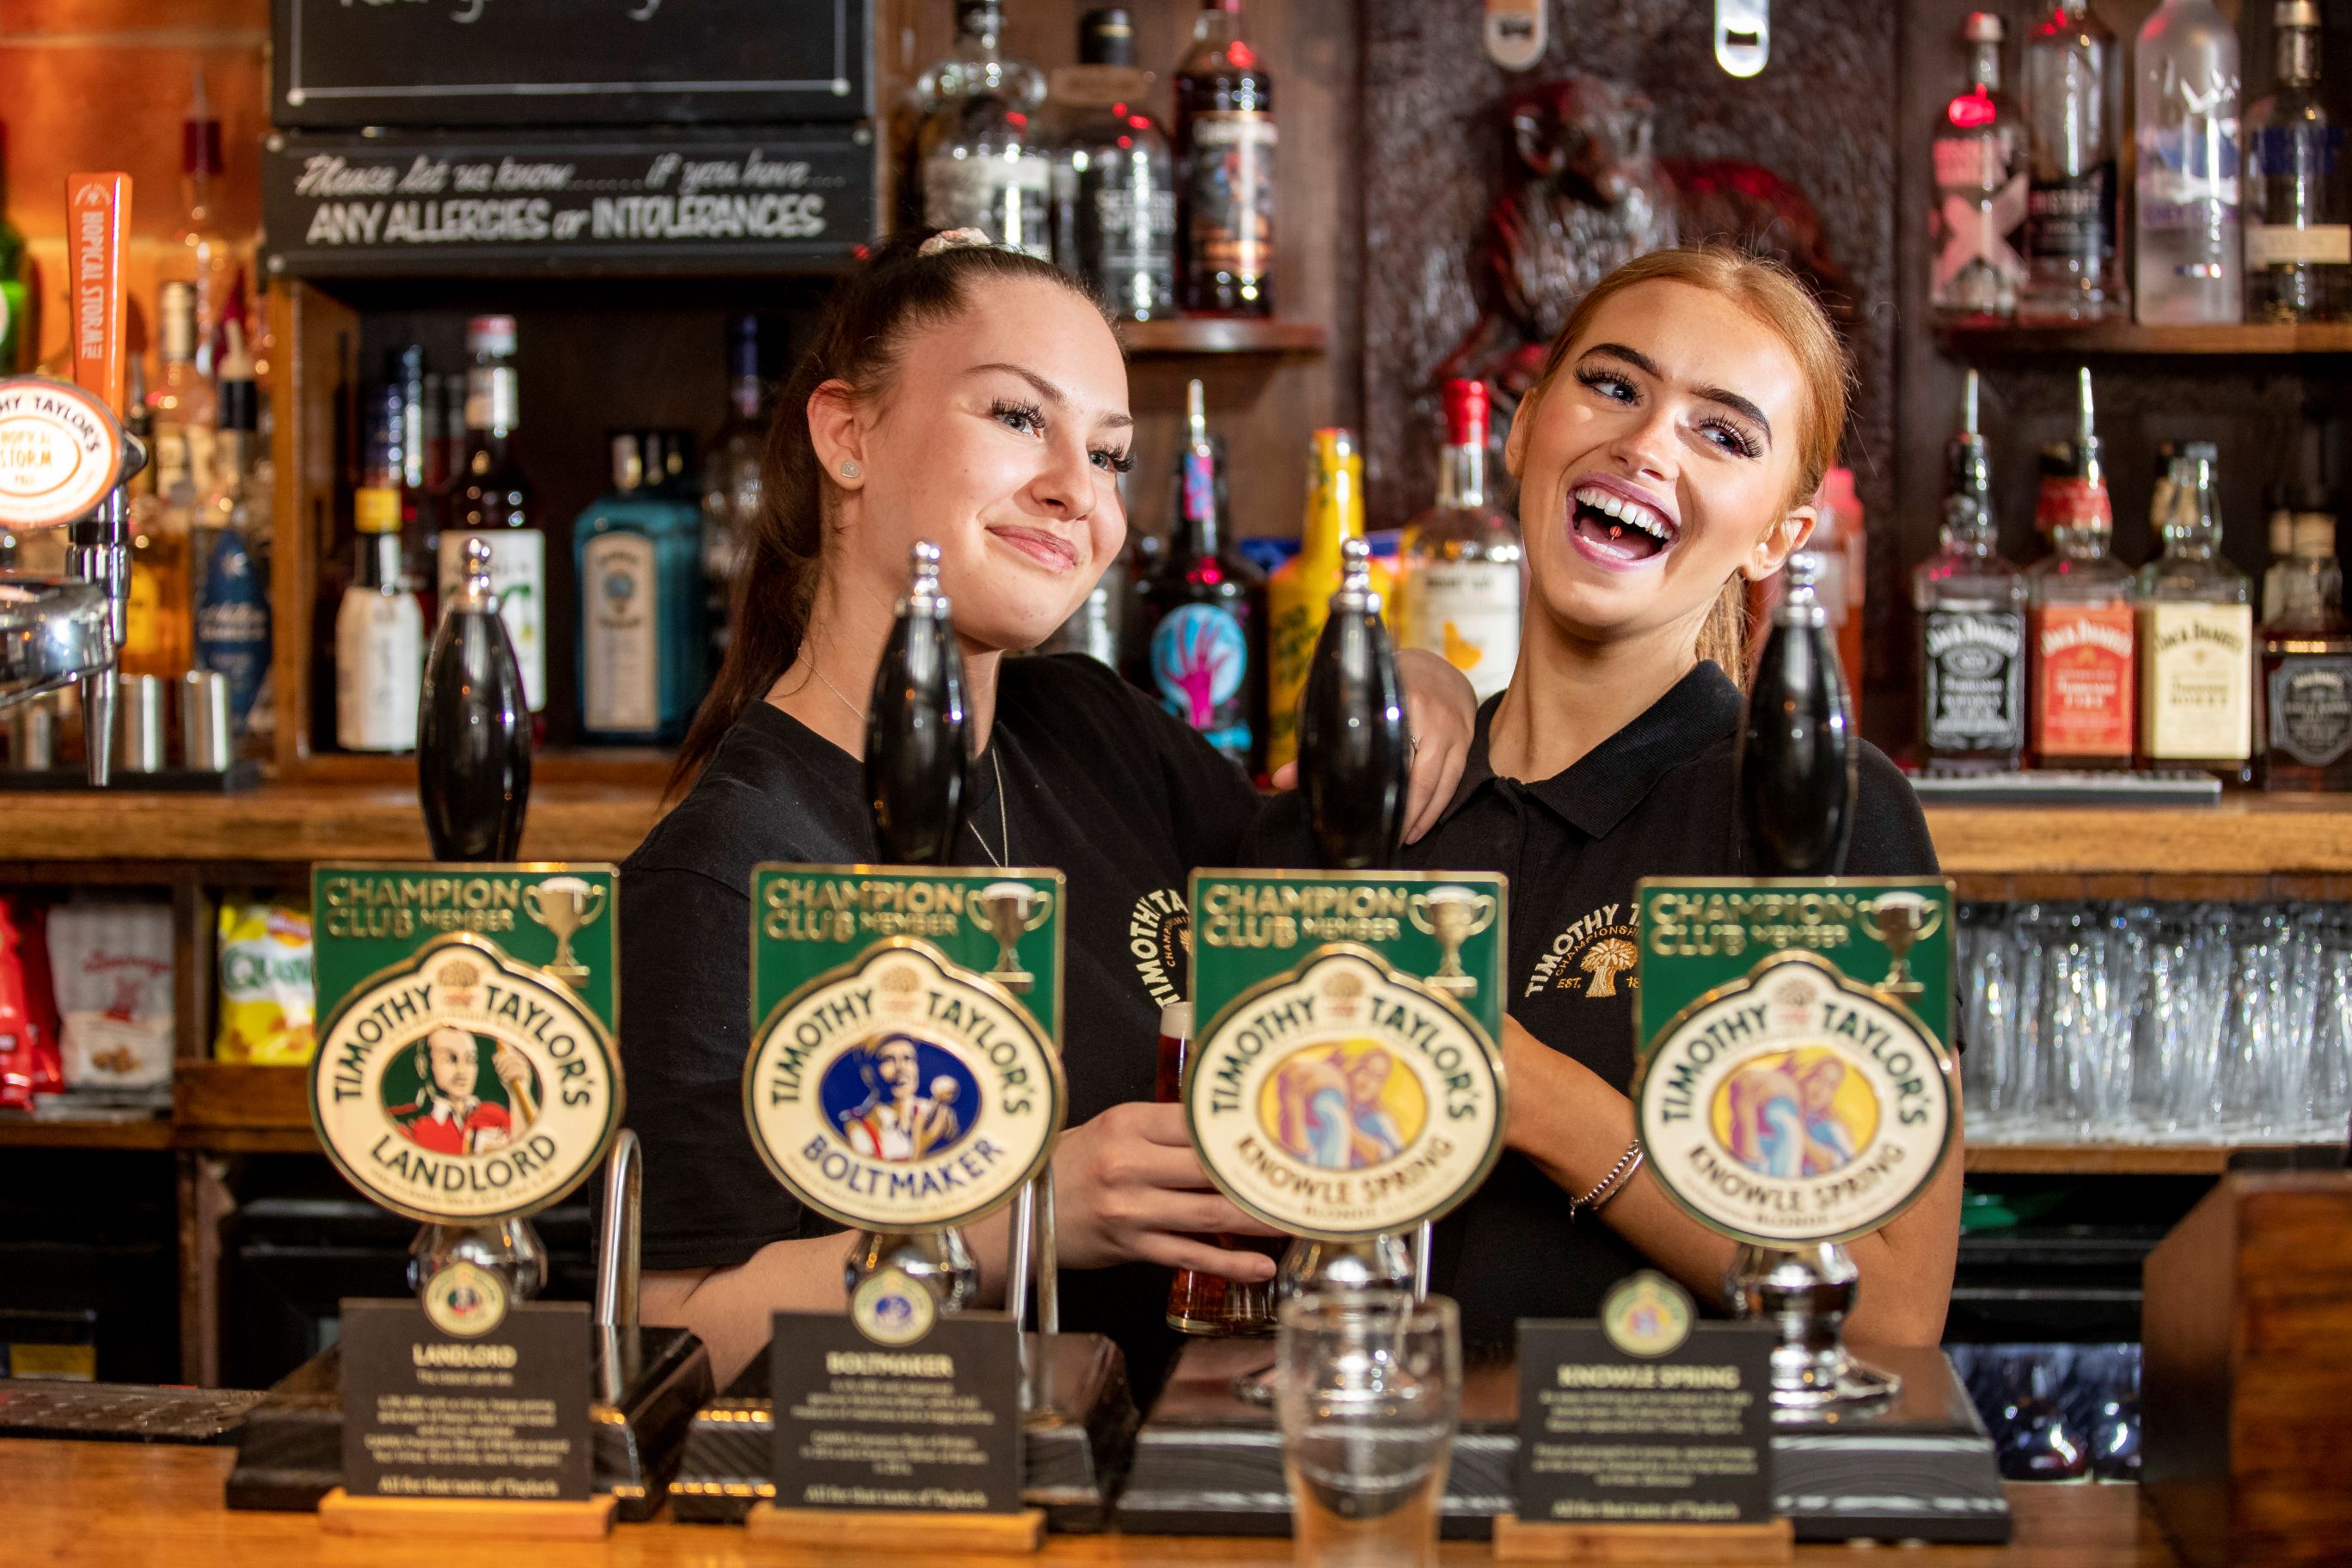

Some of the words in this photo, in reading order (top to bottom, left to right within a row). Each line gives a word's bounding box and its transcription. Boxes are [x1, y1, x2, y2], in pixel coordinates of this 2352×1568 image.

[305, 200, 386, 245] ANY
[383, 197, 552, 242] ALLERGIES
[551, 209, 591, 240] or
[592, 193, 826, 238] INTOLERANCES
[82, 285, 104, 344] STORM
[325, 877, 520, 909] CHAMPION
[763, 878, 965, 914] CHAMPION
[1204, 885, 1408, 918] CHAMPION
[1650, 894, 1859, 925] CHAMPION
[325, 907, 413, 939] CLUB
[420, 909, 515, 932] MEMBER
[763, 909, 855, 942] CLUB
[1204, 915, 1298, 948] CLUB
[1525, 903, 1620, 998] TIMOTHY
[1650, 924, 1746, 956] CLUB
[1130, 896, 1181, 1010] TIMOTHY
[1557, 977, 1582, 989] EST.
[334, 983, 434, 1105] TIMOTHY
[484, 985, 591, 1107] TAYLOR'S
[771, 989, 876, 1107] TIMOTHY
[925, 990, 1031, 1115] TAYLOR'S
[1210, 995, 1318, 1115] TIMOTHY
[1369, 997, 1476, 1121] TAYLOR'S
[1662, 1002, 1771, 1124] TIMOTHY
[1822, 1003, 1927, 1128] TAYLOR'S
[371, 1134, 555, 1192] LANDLORD
[802, 1136, 1005, 1199] BOLTMAKER
[1237, 1136, 1352, 1205] KNOWLE
[1362, 1136, 1455, 1201] SPRING
[1689, 1145, 1805, 1212] KNOWLE
[1812, 1142, 1906, 1208] SPRING
